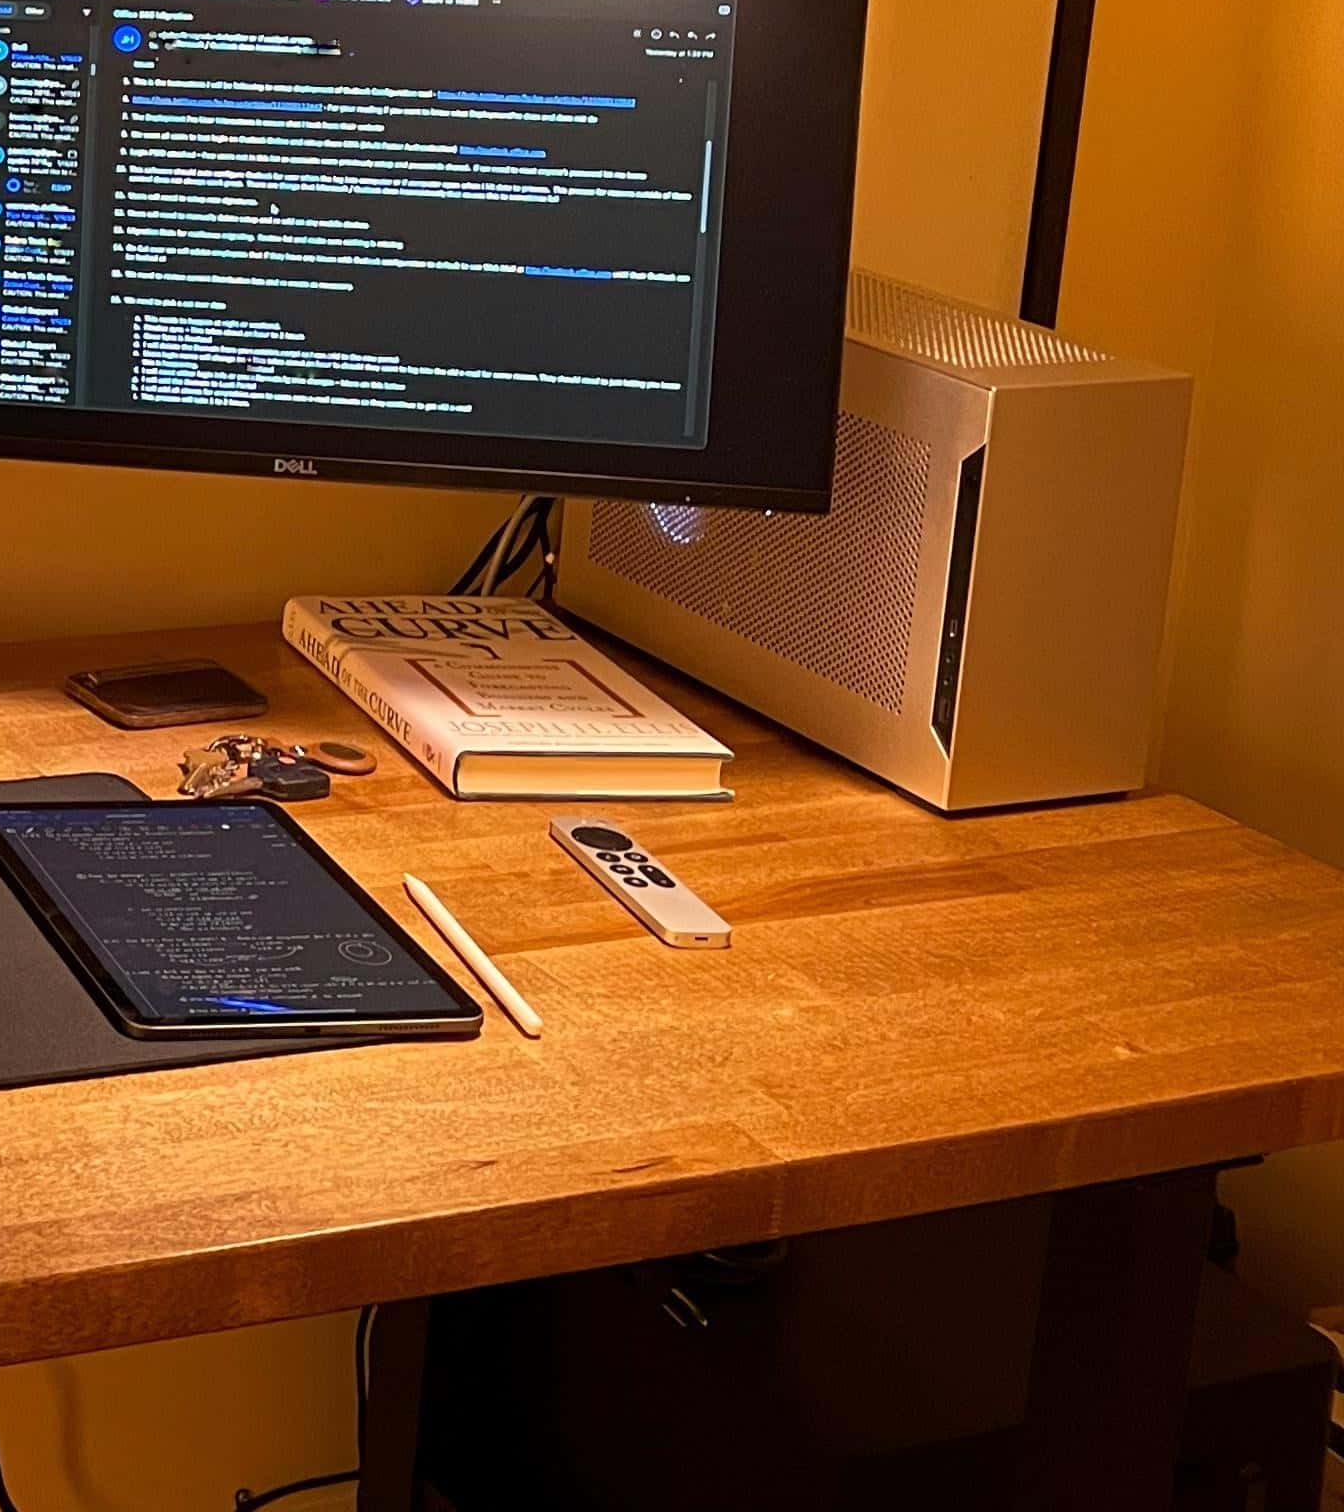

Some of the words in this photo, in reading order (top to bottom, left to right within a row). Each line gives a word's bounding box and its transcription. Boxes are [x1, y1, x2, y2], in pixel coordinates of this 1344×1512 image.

[274, 458, 318, 475] DELL
[319, 599, 483, 615] AHEAD
[331, 616, 576, 641] CURVE
[299, 629, 341, 679] AHEAD
[368, 692, 412, 745] CURVE
[449, 720, 566, 735] JOSEPH
[614, 722, 699, 736] ELLIS
